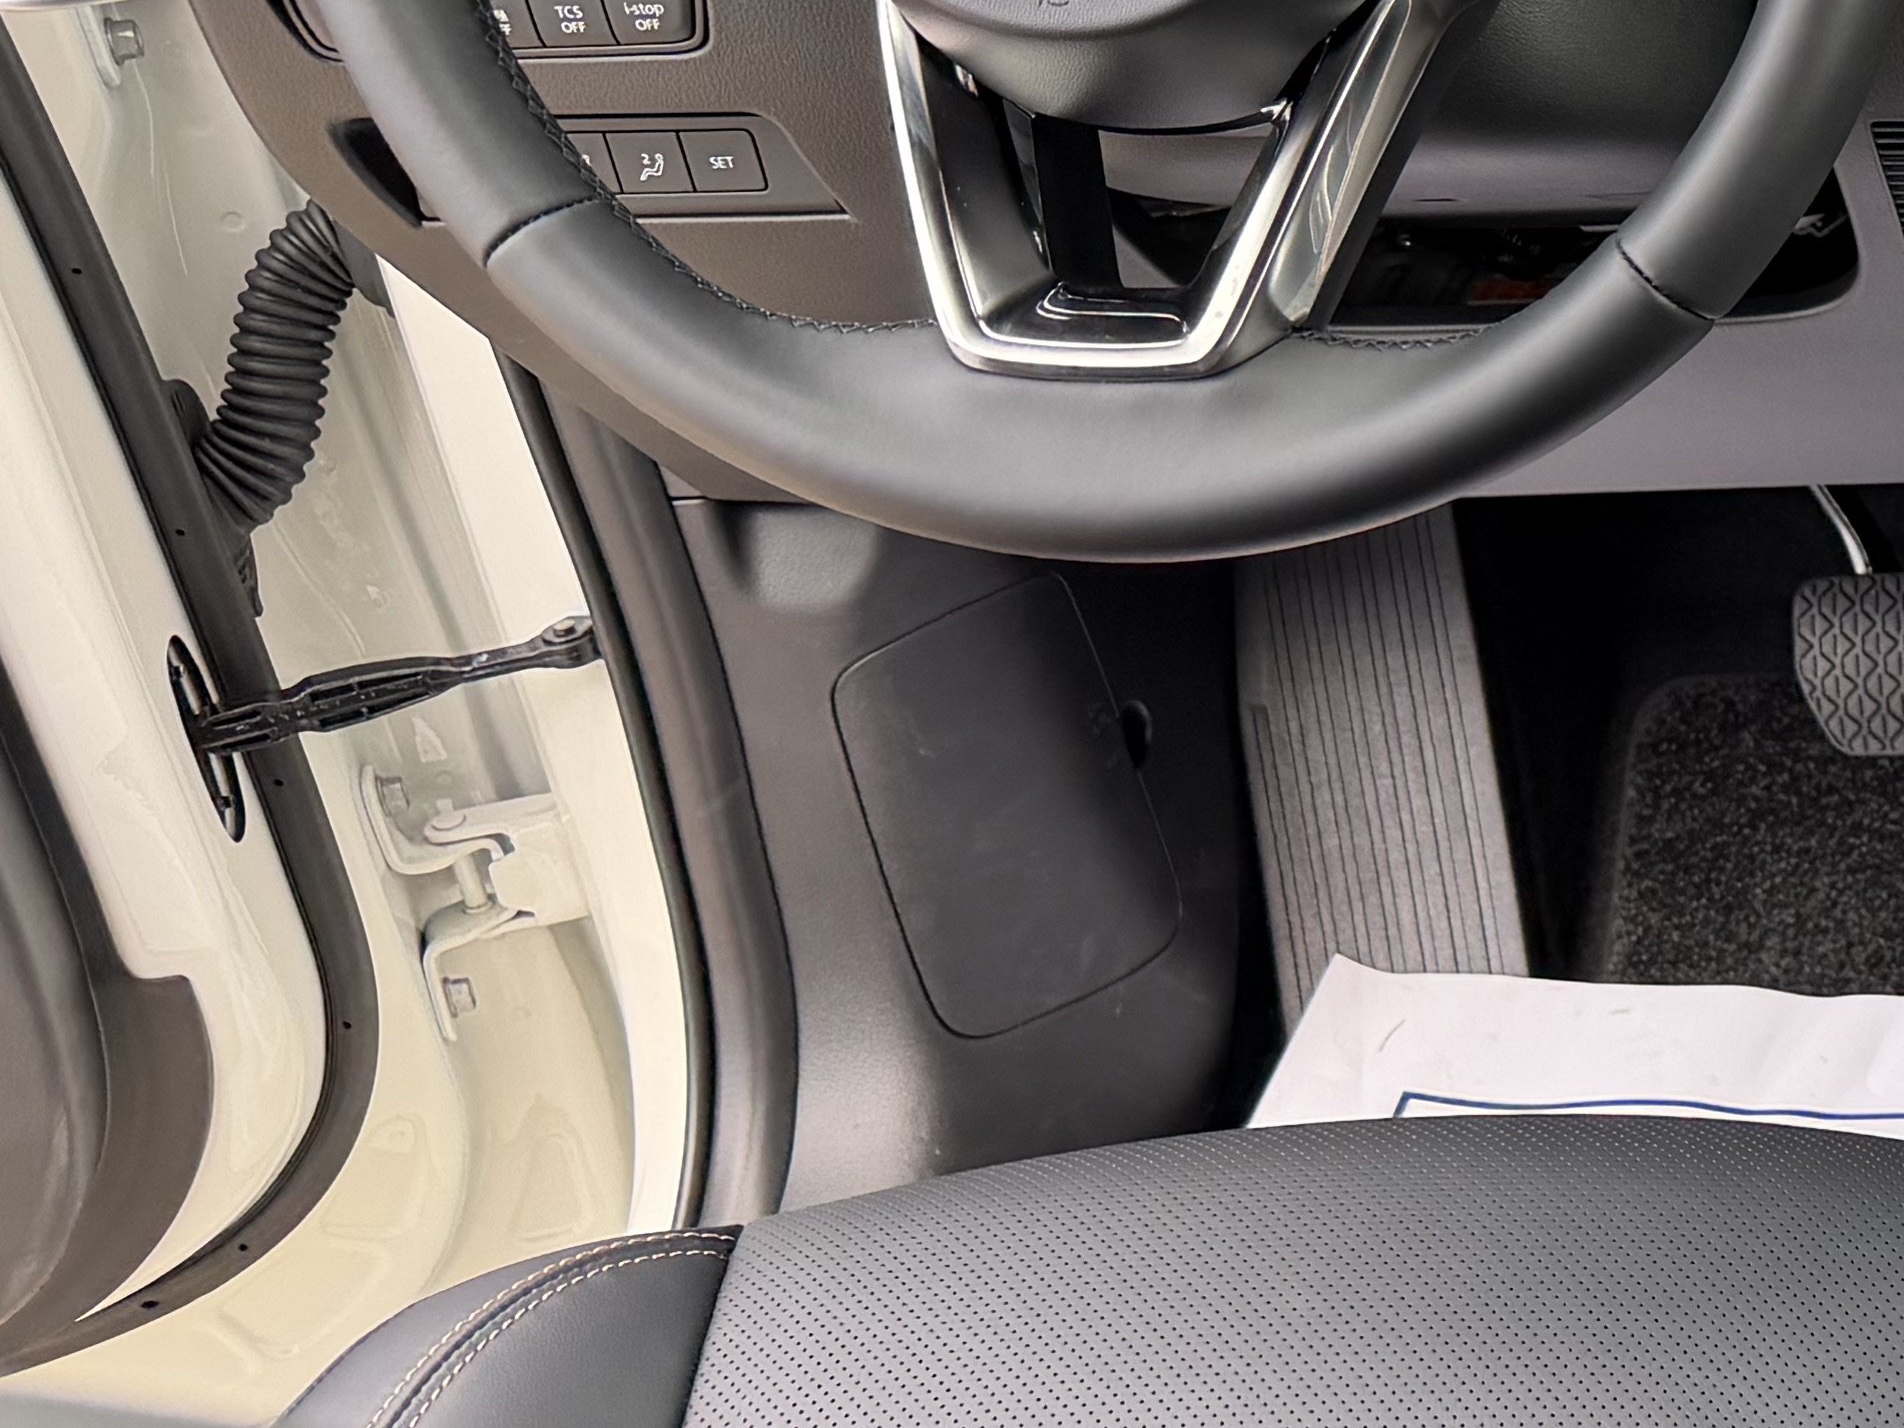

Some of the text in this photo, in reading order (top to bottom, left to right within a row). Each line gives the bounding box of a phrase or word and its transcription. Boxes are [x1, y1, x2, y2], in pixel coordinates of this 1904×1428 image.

[554, 5, 583, 19] TCS
[561, 21, 586, 34] OFF
[634, 18, 660, 31] OFF
[709, 156, 734, 169] SET
